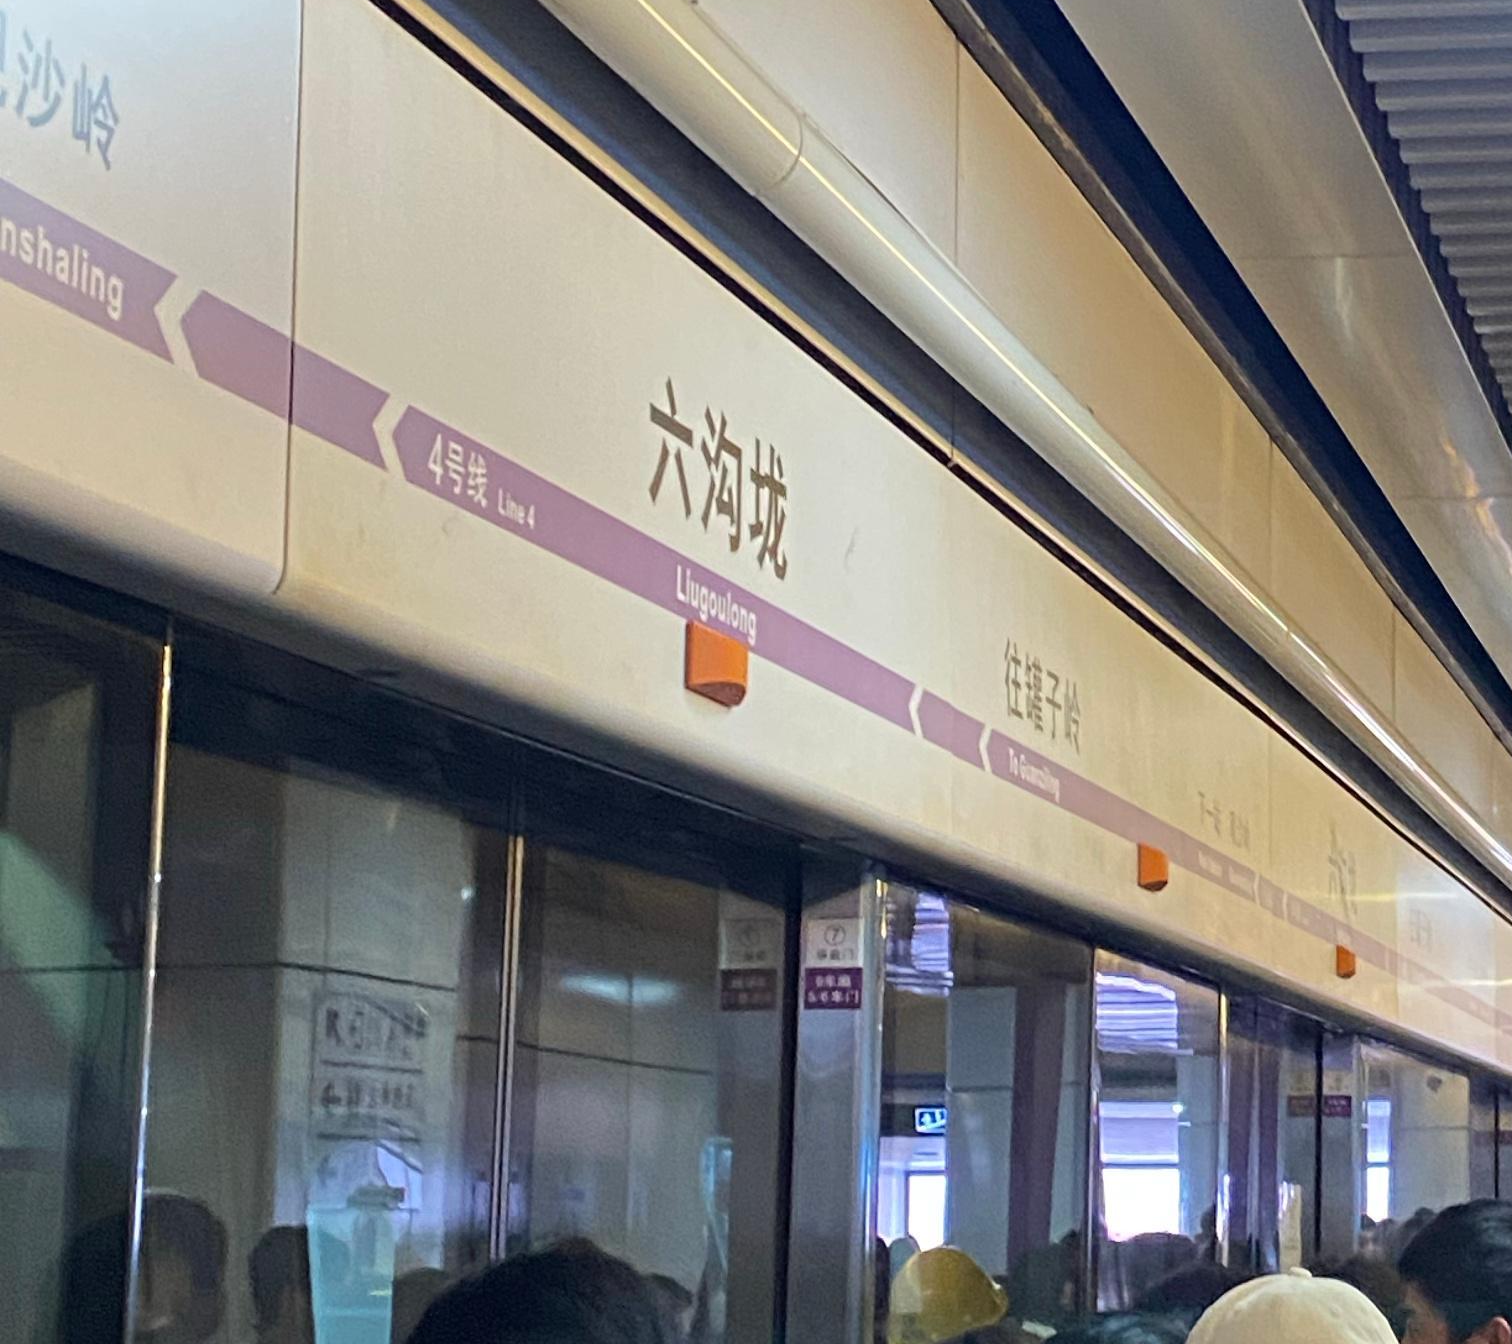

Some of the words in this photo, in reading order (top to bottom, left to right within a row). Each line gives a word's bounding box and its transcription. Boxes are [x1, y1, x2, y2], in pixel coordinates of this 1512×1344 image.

[0, 10, 119, 171] 沙岭
[427, 432, 489, 509] 4号线
[498, 487, 526, 525] Line
[527, 504, 536, 530] 4
[648, 376, 788, 582] 六沟垅
[676, 564, 758, 646] Liugoulong
